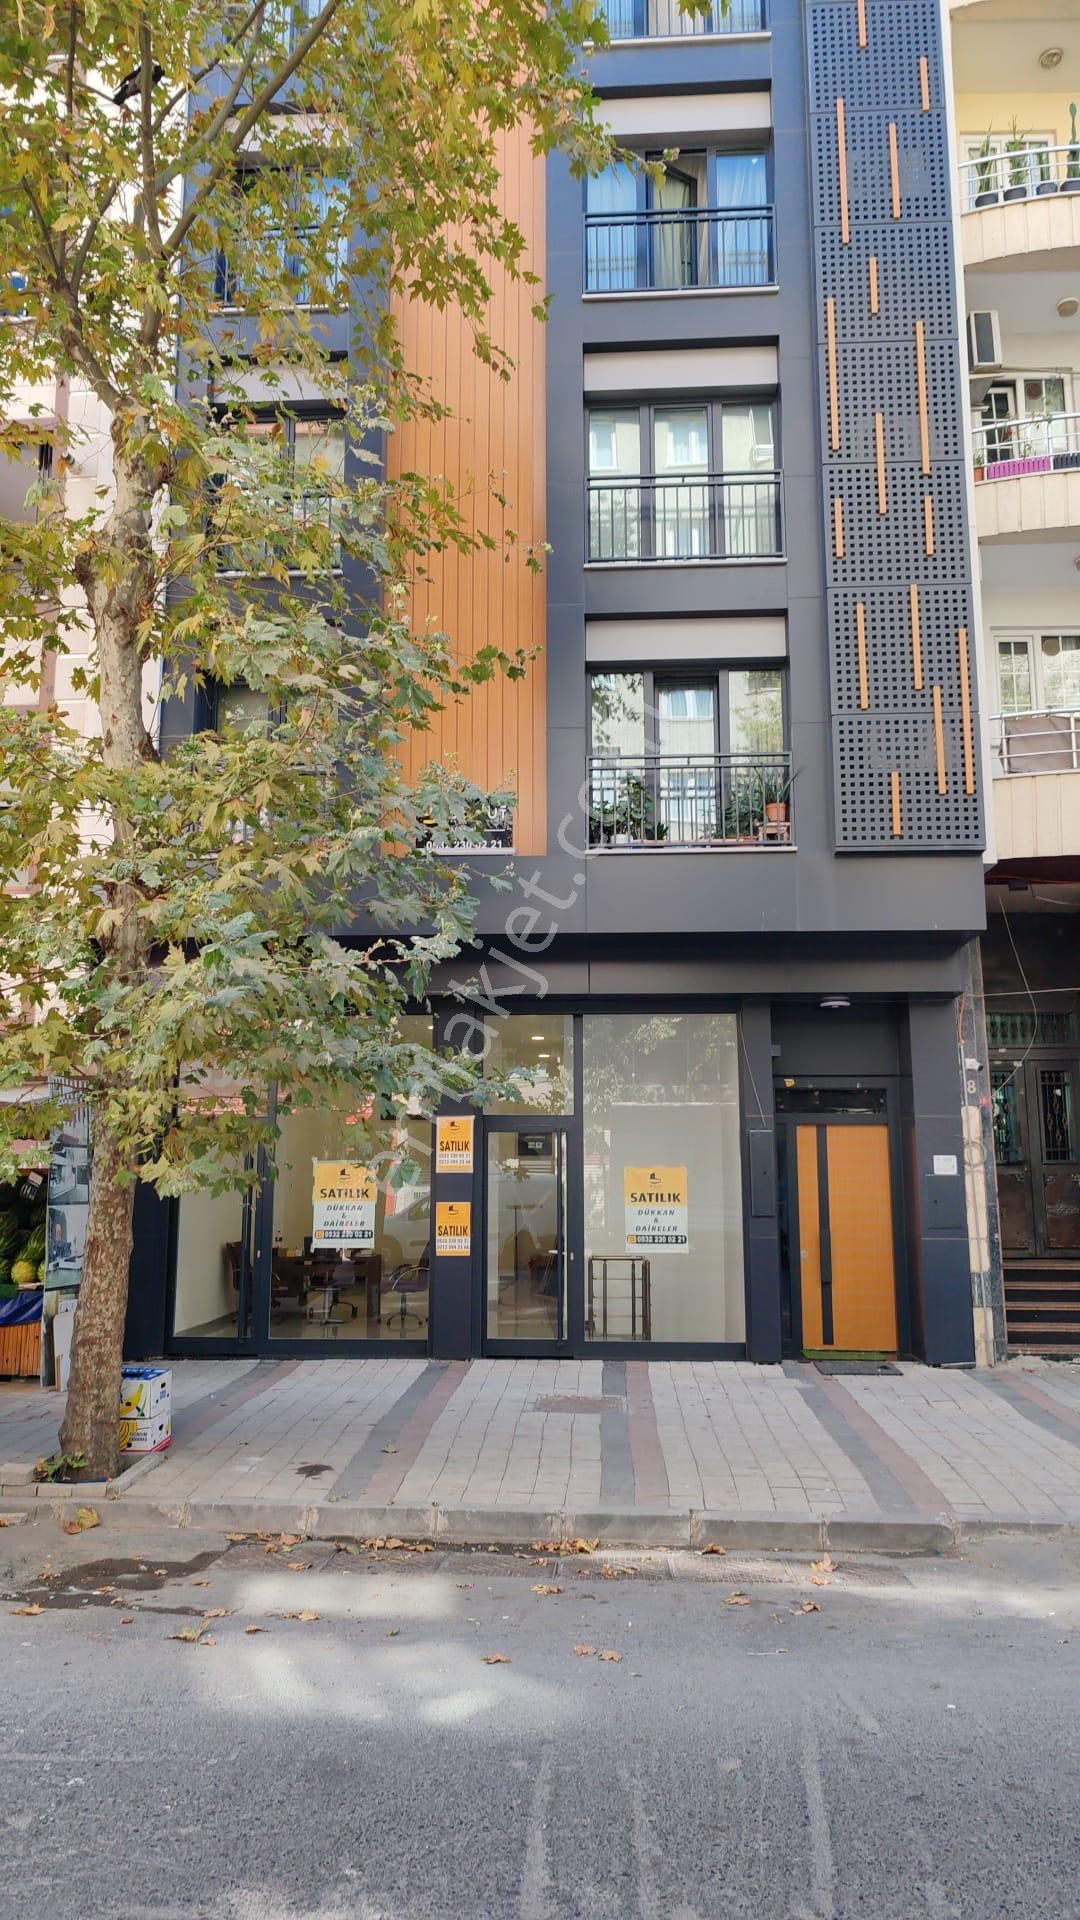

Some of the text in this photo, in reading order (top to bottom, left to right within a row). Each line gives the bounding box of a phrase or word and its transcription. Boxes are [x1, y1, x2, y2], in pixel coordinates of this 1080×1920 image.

[967, 1080, 976, 1094] 8
[439, 1140, 470, 1152] SATILIK
[630, 1192, 681, 1203] SATILIK
[637, 1208, 675, 1216] DÜKKAN
[437, 1225, 469, 1237] SATILIK
[637, 1235, 685, 1244] 0532 230 02 21
